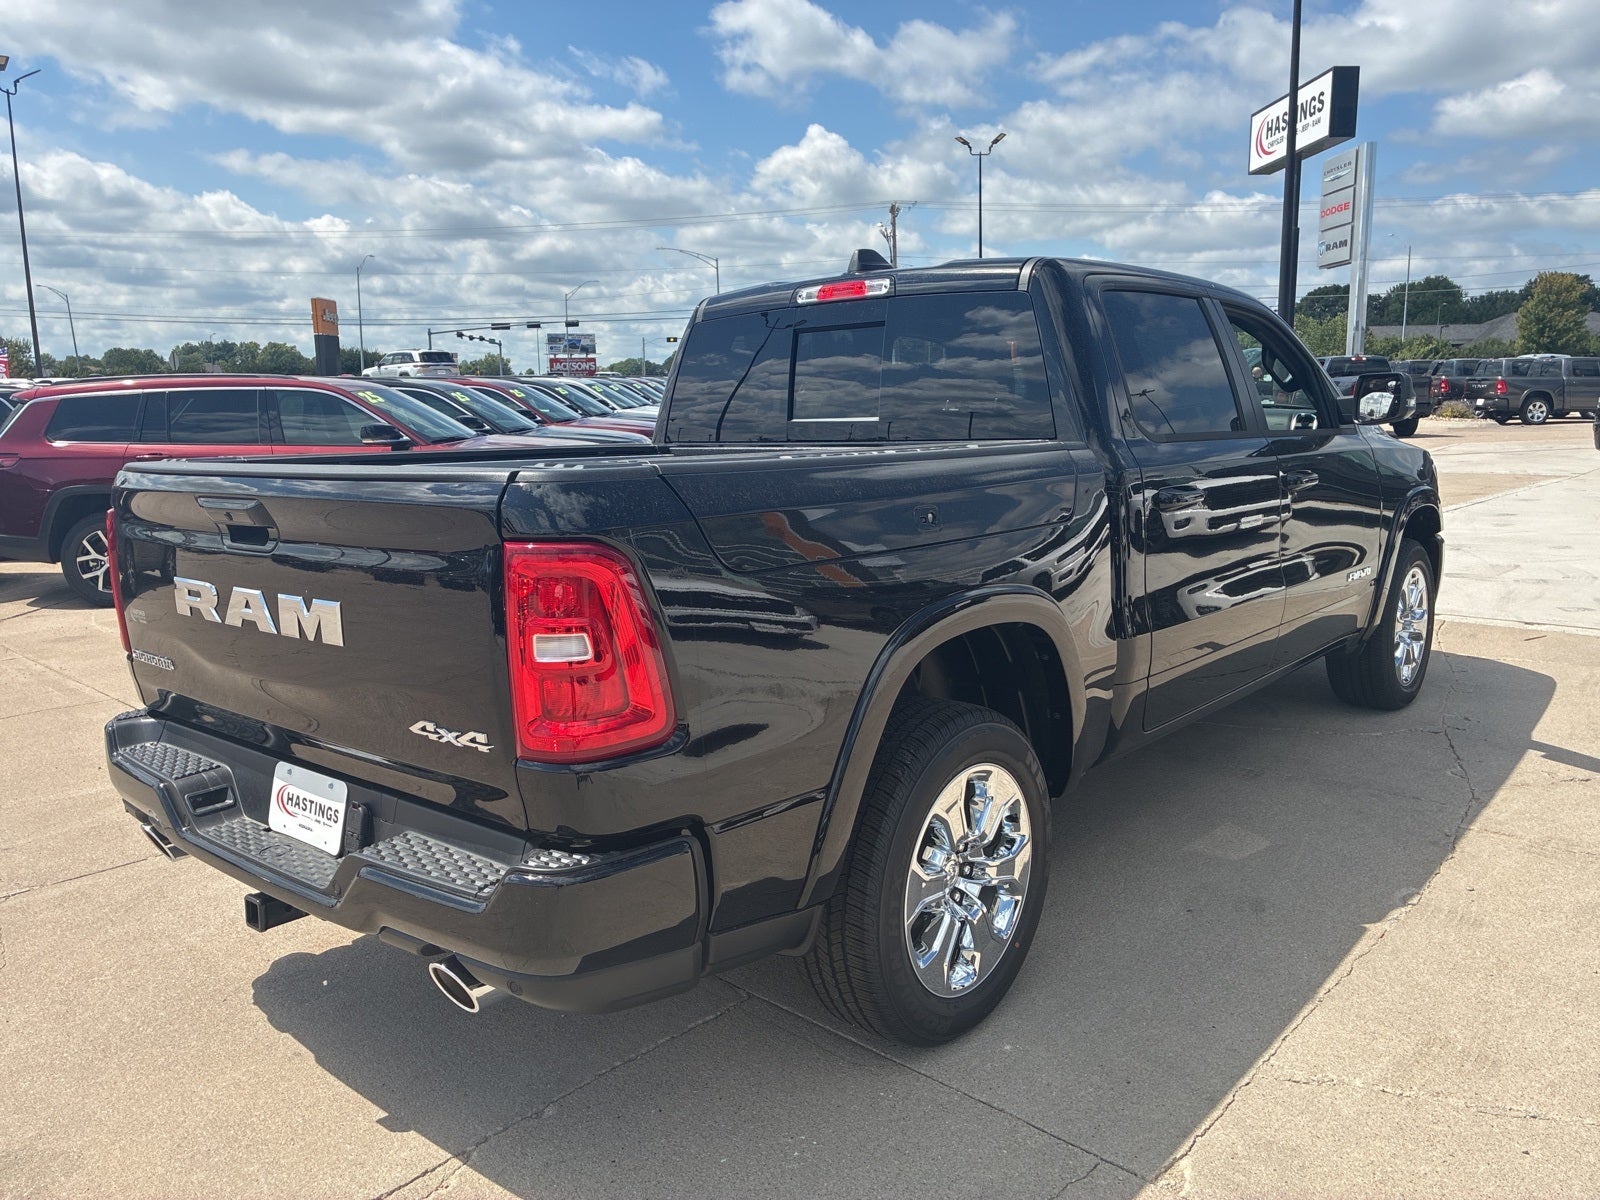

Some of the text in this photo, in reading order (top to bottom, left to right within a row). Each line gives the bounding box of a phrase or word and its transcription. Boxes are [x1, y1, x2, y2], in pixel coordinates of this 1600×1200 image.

[1266, 91, 1325, 140] HASNGS
[1323, 161, 1352, 176] CHRYSLER
[1320, 202, 1350, 218] DODGE
[1325, 239, 1348, 252] RAM
[358, 391, 385, 404] 25
[174, 576, 344, 647] RAM
[286, 791, 340, 824] HASTINGS
